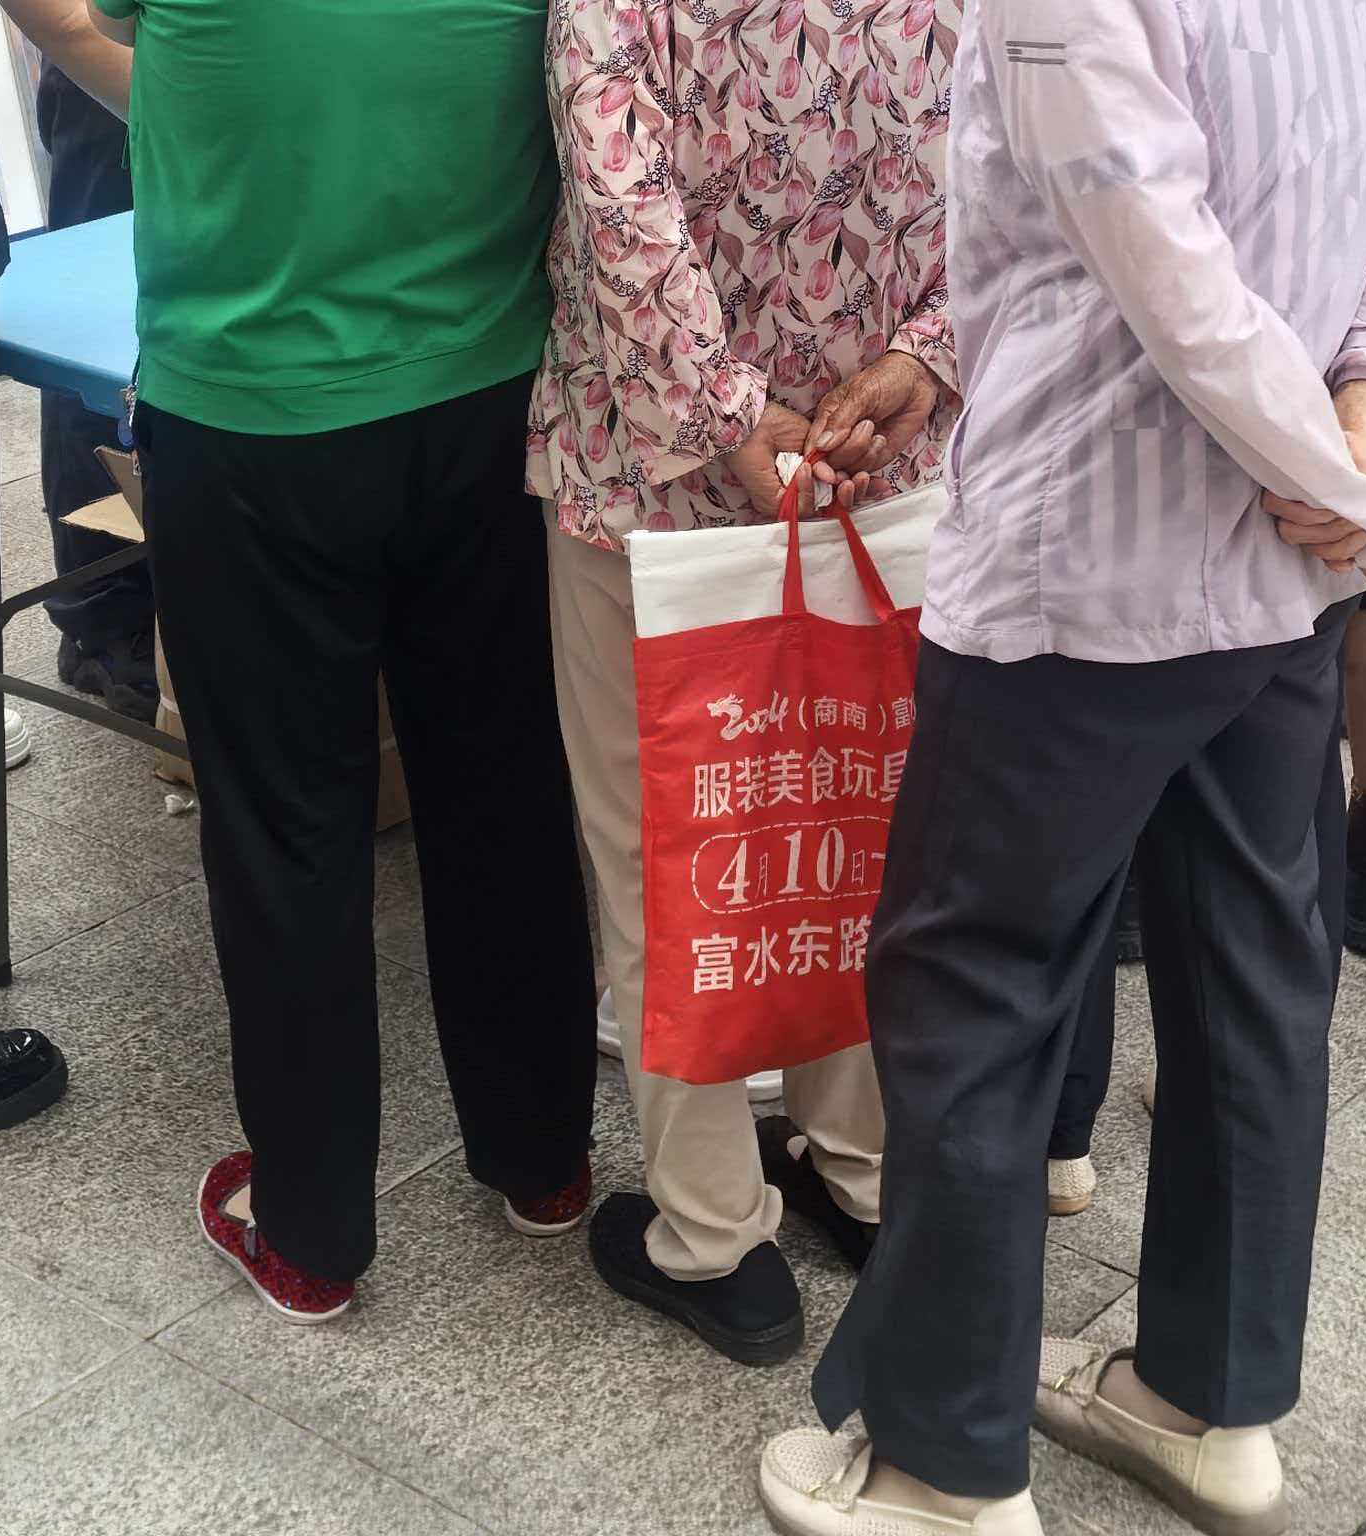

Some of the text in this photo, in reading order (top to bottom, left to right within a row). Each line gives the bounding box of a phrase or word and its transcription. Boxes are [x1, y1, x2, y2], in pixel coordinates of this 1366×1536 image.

[693, 746, 908, 818] 服装美食玩具
